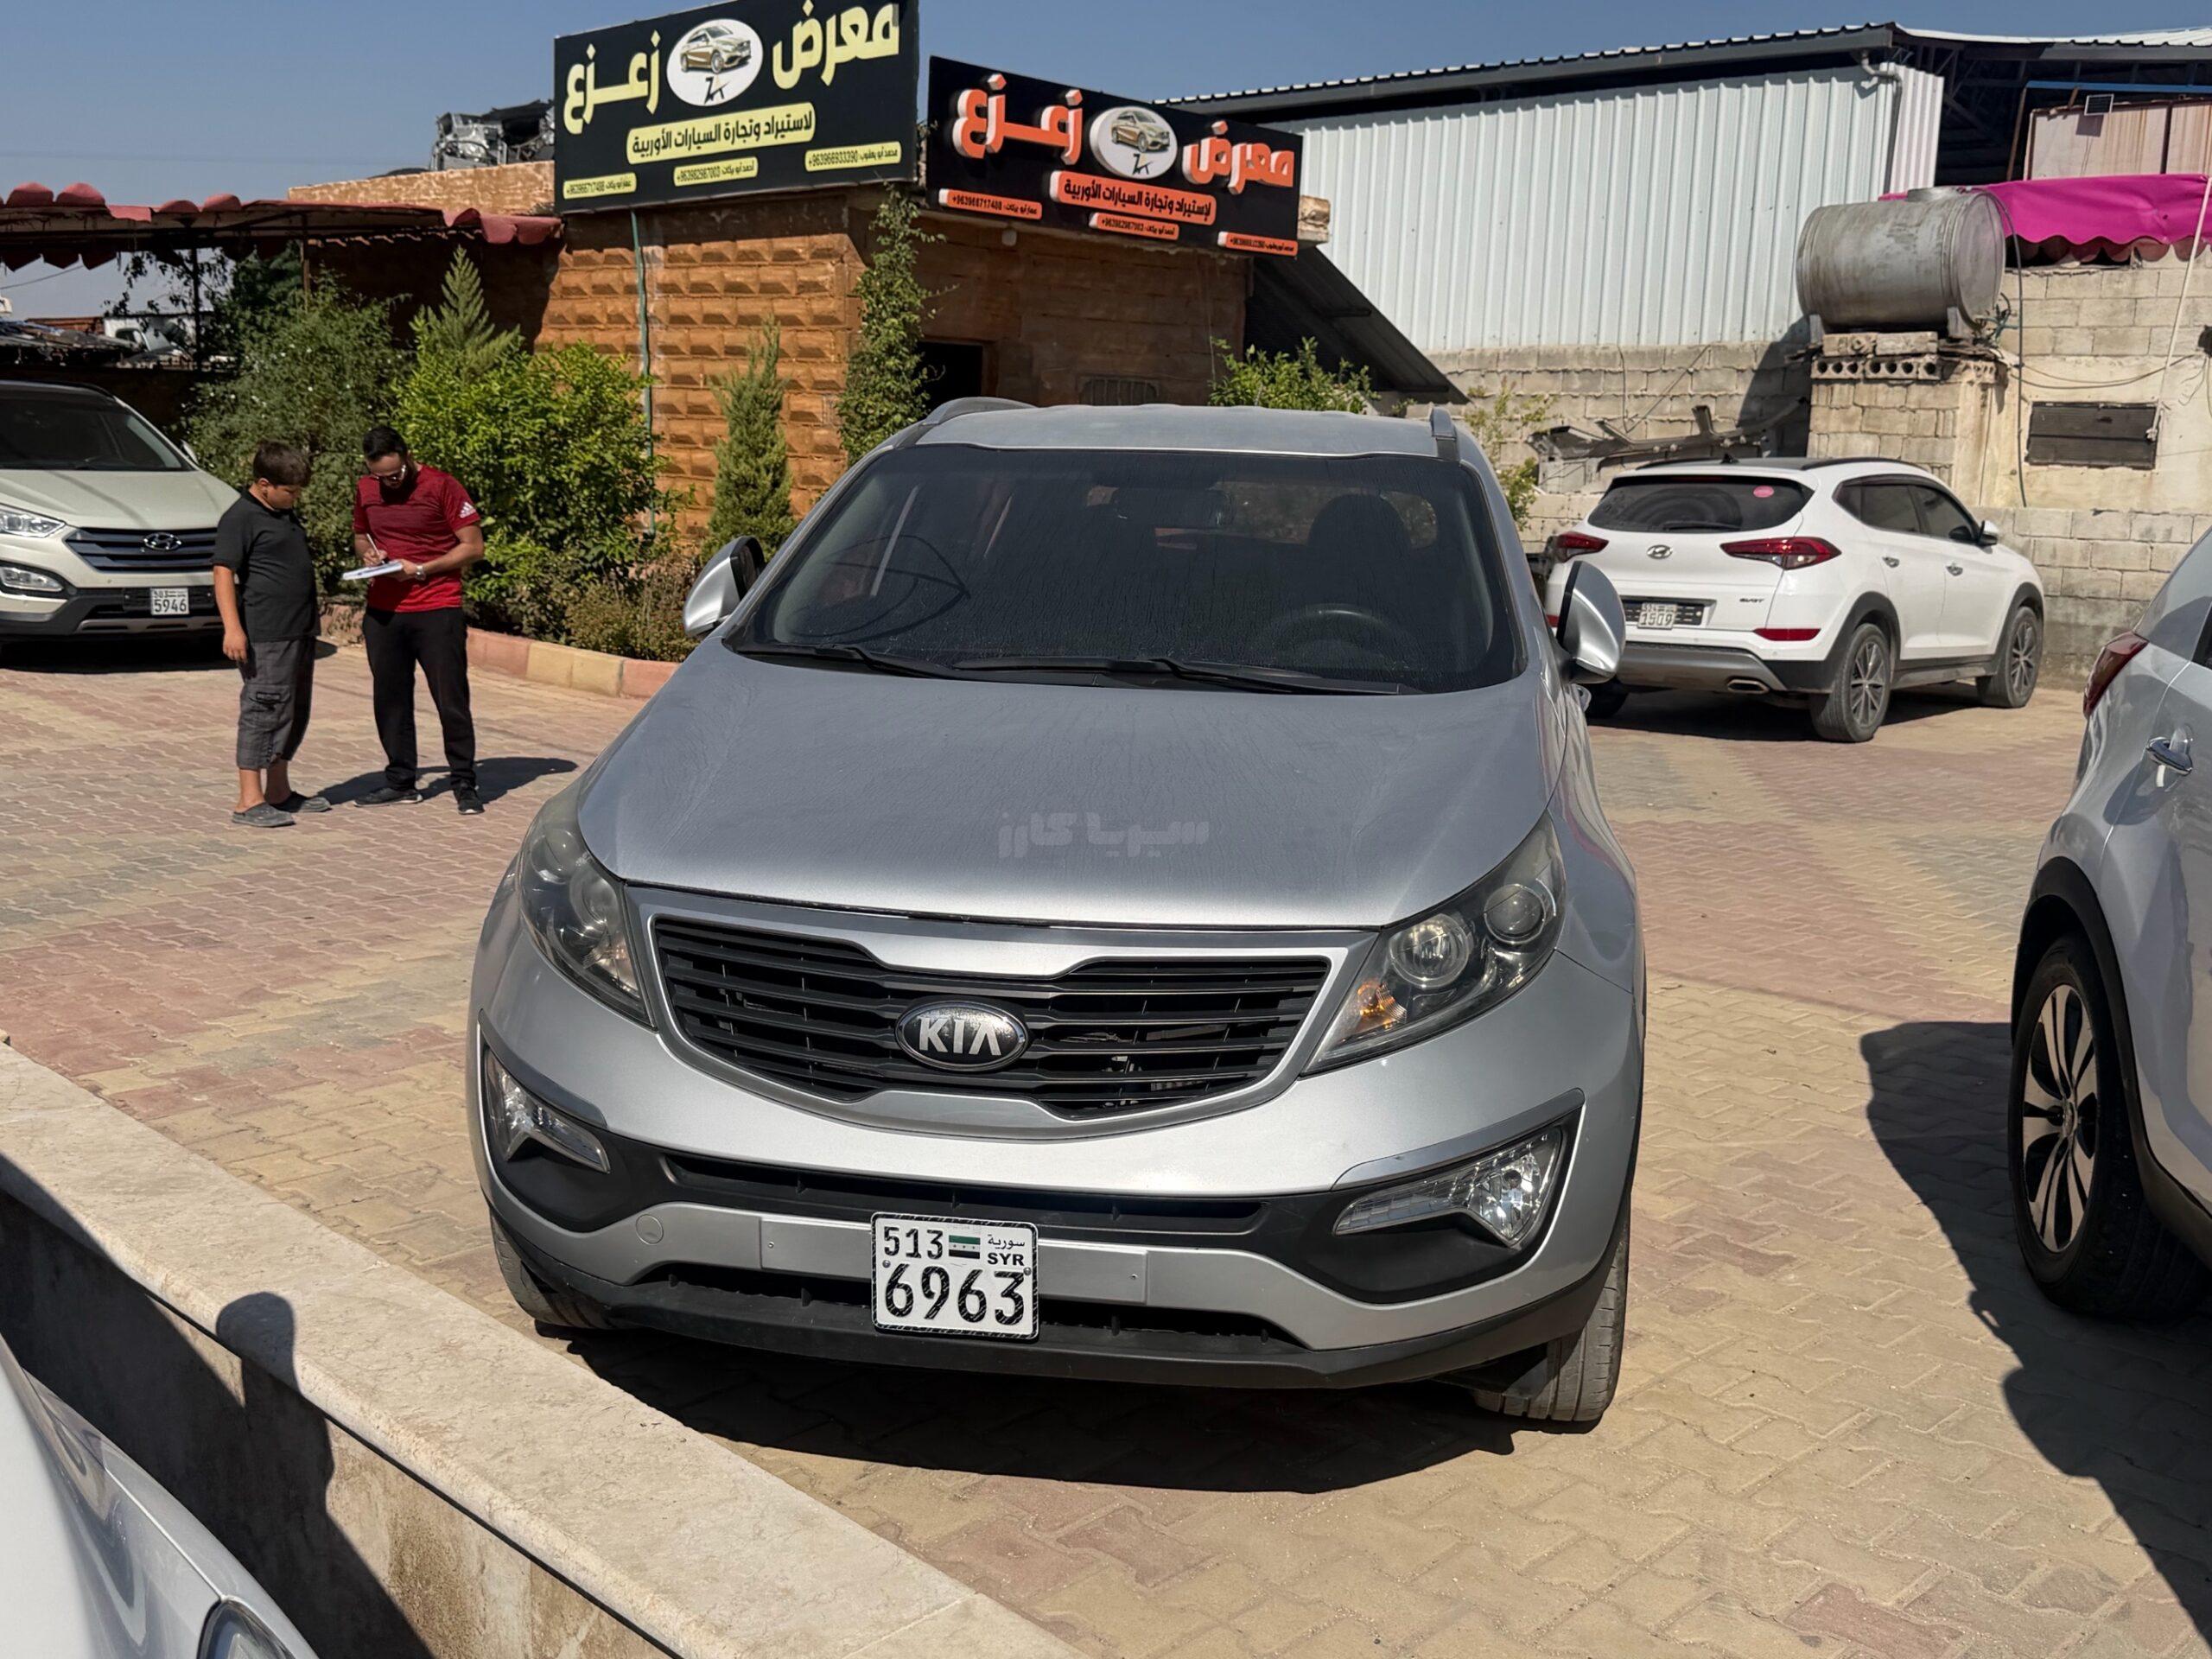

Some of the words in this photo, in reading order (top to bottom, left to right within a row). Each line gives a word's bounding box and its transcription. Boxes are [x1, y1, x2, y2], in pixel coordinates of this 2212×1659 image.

[772, 0, 899, 89] معرض
[632, 128, 672, 157] الأوربية
[674, 124, 721, 150] السيارات
[724, 119, 761, 145] وتجارة
[1183, 120, 1294, 194] معرض
[1064, 180, 1101, 200] الأوربية
[1103, 186, 1143, 207] السيارات
[1144, 192, 1173, 214] وتجارة
[155, 598, 187, 613] 5946
[918, 1017, 1002, 1057] KIA
[884, 1226, 944, 1260] 513
[988, 1234, 1026, 1250] سورية
[987, 1252, 1026, 1267] SYR
[885, 1263, 1026, 1326] 6963
